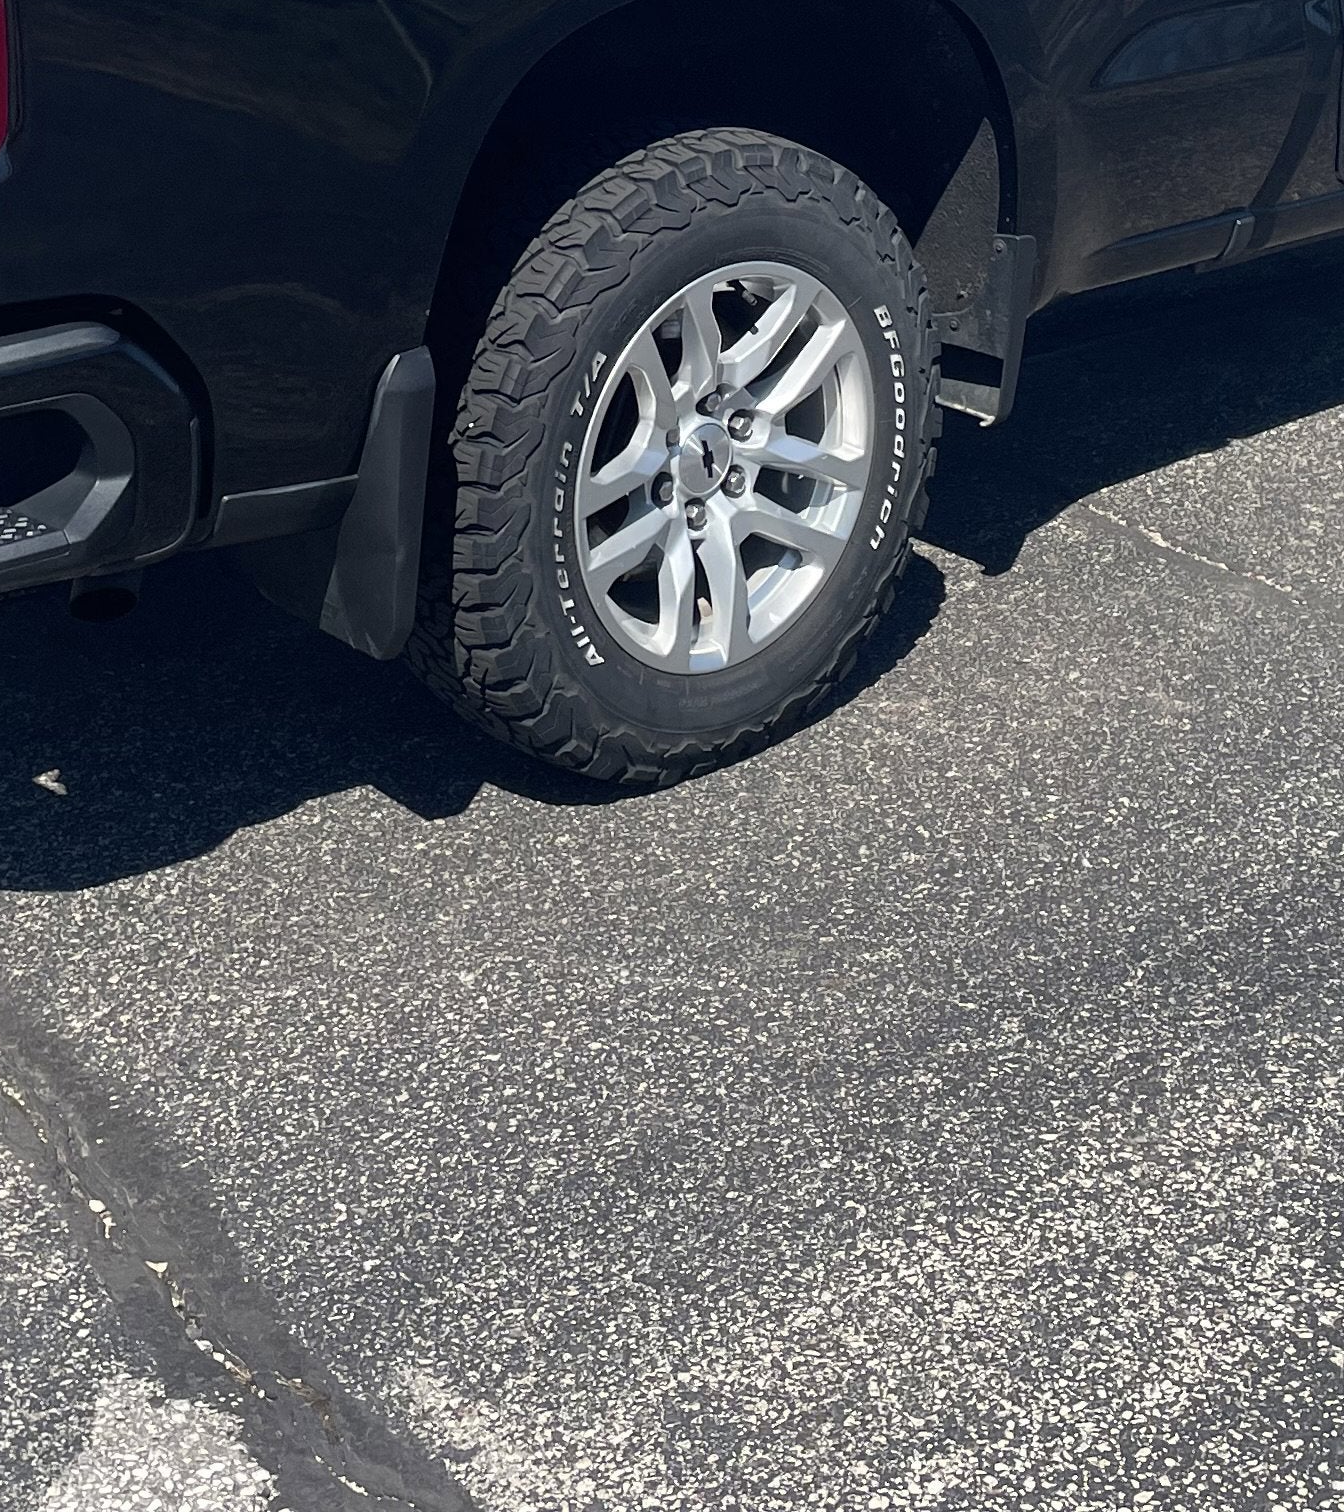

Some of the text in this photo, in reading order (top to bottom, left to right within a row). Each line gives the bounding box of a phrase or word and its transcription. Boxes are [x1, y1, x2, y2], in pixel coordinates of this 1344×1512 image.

[553, 350, 608, 667] All-Terrain T/A
[869, 304, 906, 550] BFGoodrich
